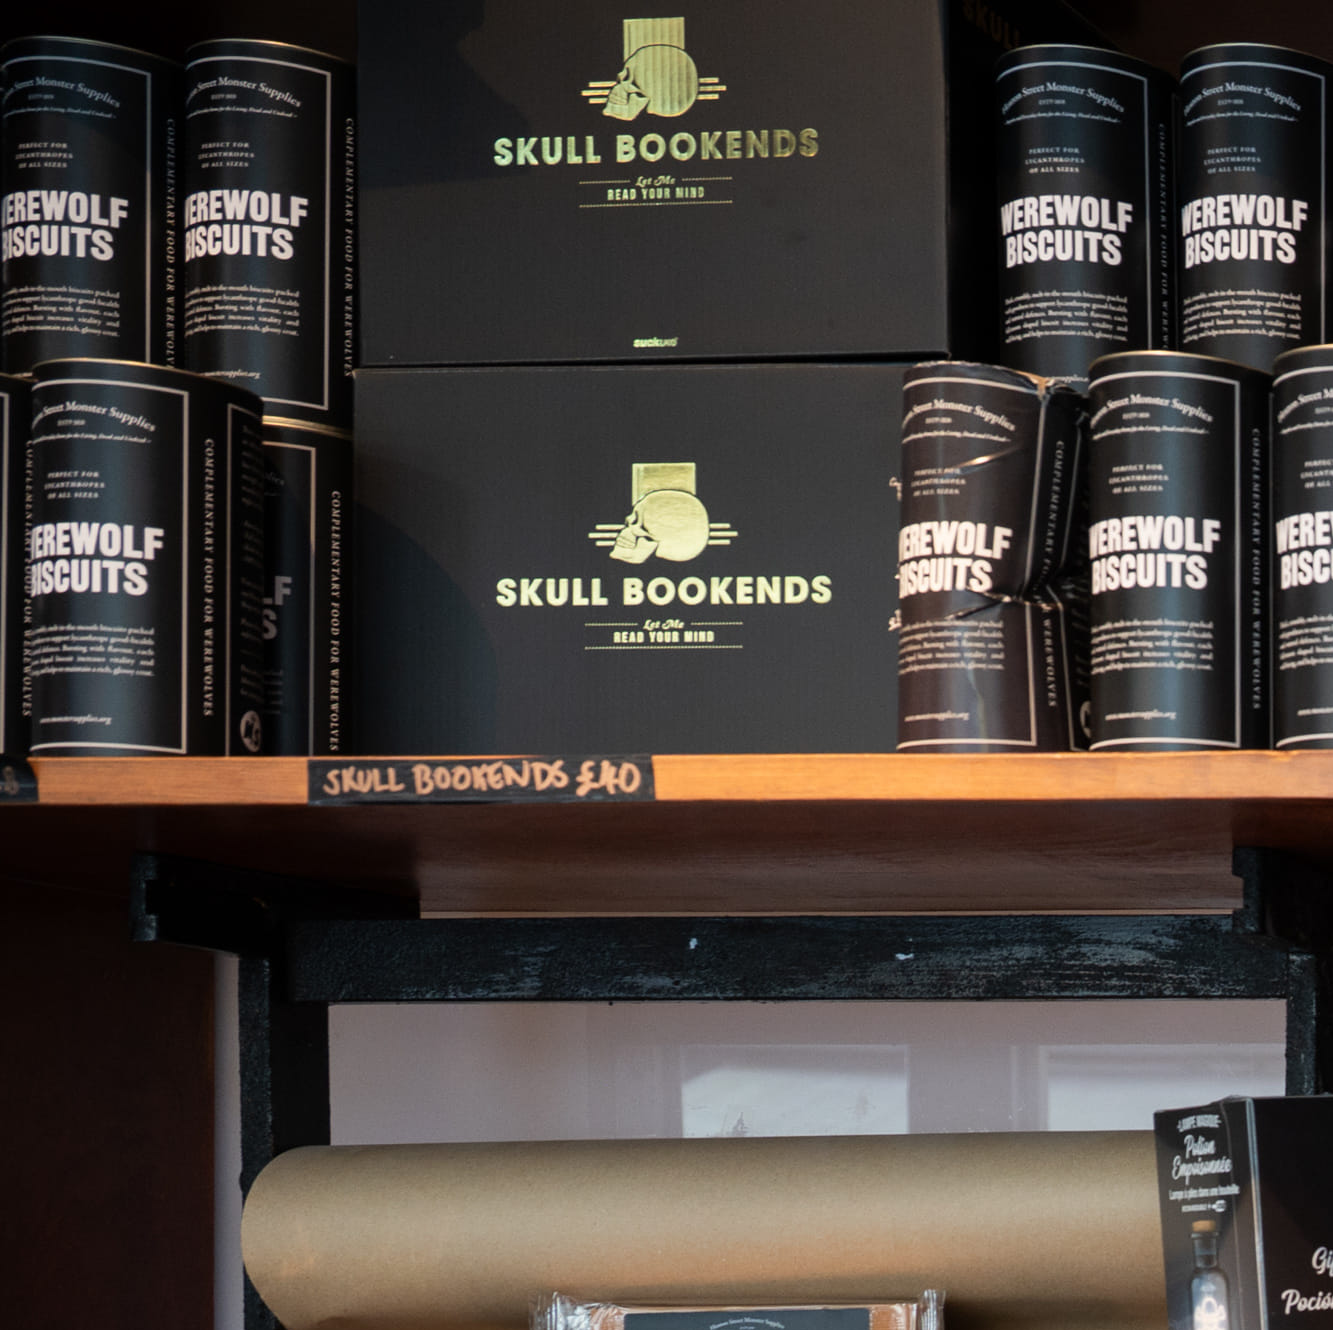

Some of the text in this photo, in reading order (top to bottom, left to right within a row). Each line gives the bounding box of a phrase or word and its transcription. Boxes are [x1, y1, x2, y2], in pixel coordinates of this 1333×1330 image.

[258, 81, 301, 107] Supplies
[493, 128, 819, 166] SKULL BOOKENDS
[608, 186, 704, 200] READ YOUR MIND
[636, 174, 676, 186] Let Me
[1000, 194, 1132, 236] WEREWOLF
[1181, 194, 1308, 237] WEREWOLF
[1006, 229, 1122, 268] BISCUITS
[1185, 229, 1296, 269] BISCUITS
[496, 576, 832, 606] SKULL BOOKENDS
[1092, 554, 1207, 594] BISCUITS
[330, 490, 340, 751] COMPLEMENTARY FOOD FOR WEREWOLVES
[614, 631, 714, 643] READ YOUR MIND
[643, 619, 684, 630] Let Me
[323, 760, 641, 797] SKULL BOOKENDS £40
[1184, 1135, 1216, 1158] Potion
